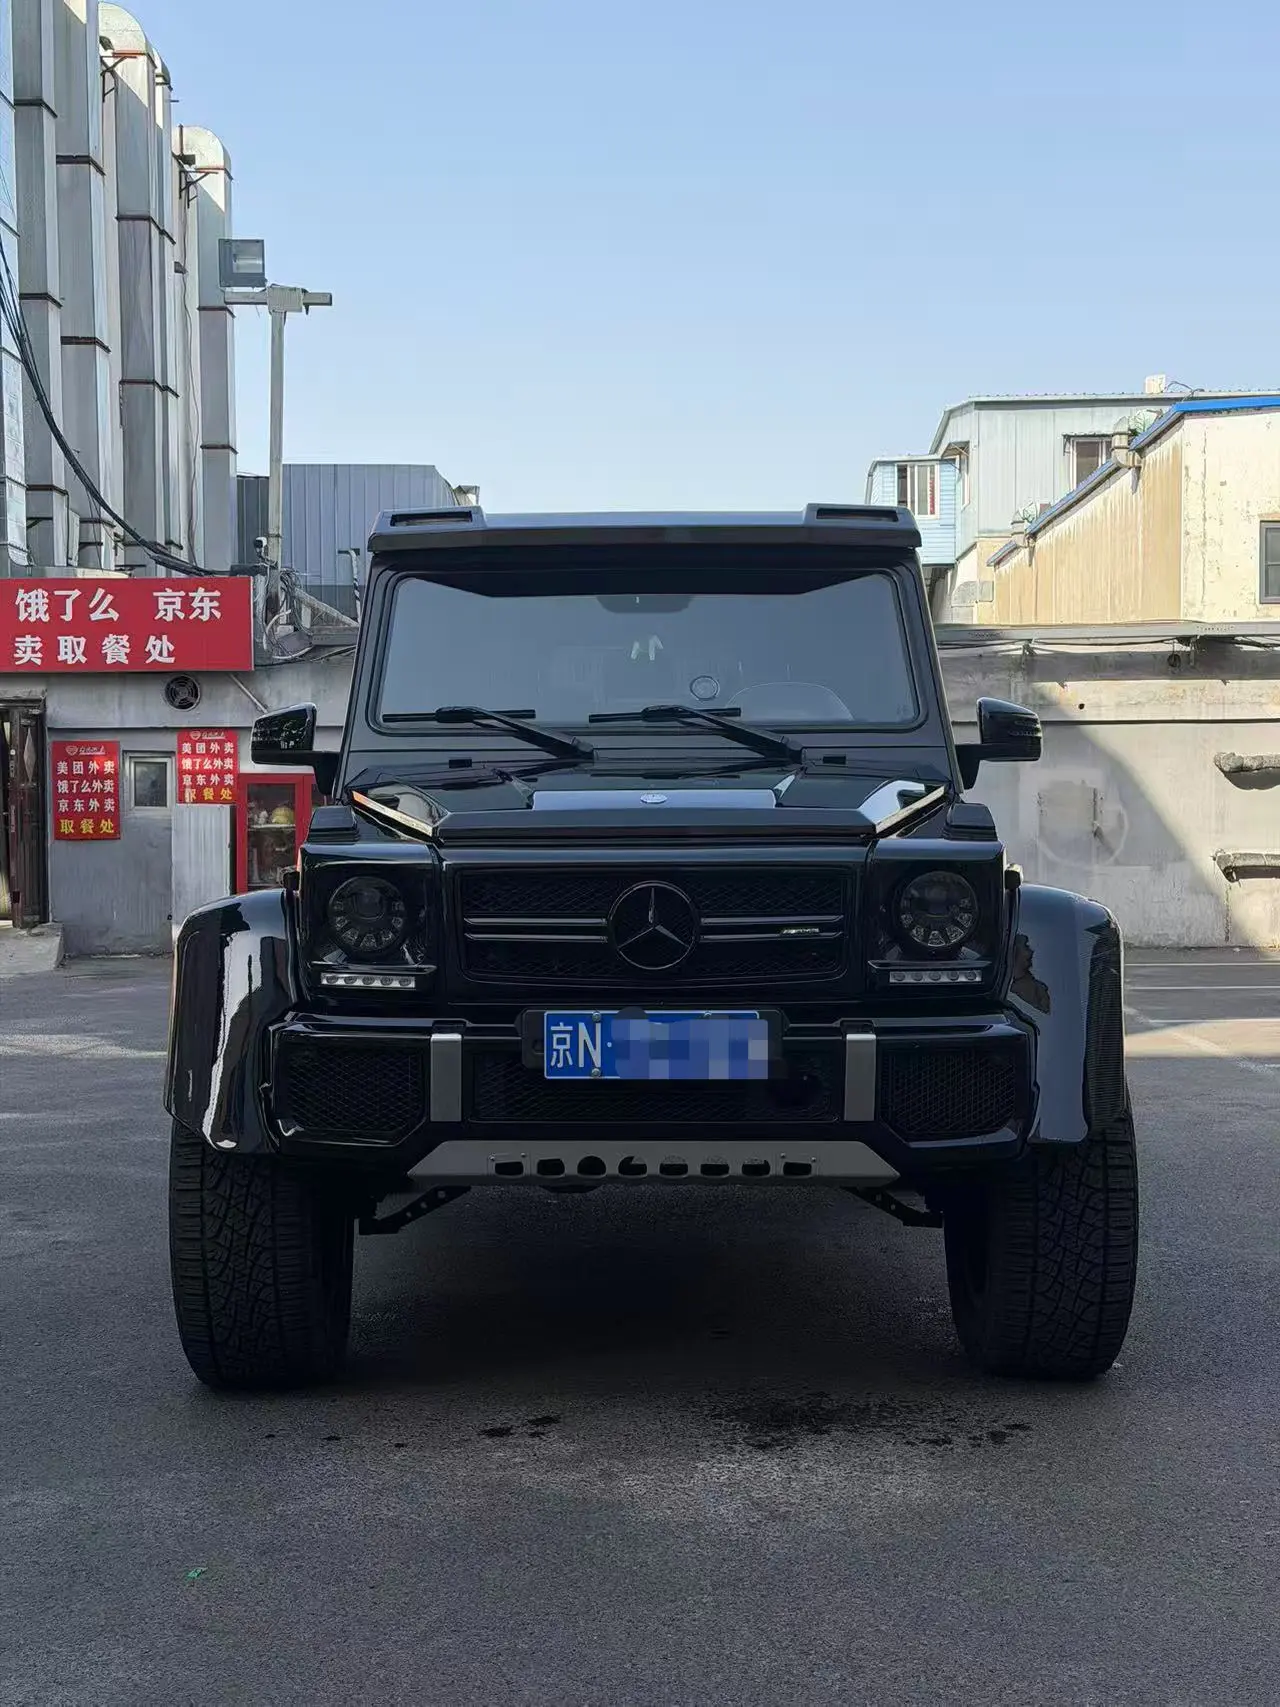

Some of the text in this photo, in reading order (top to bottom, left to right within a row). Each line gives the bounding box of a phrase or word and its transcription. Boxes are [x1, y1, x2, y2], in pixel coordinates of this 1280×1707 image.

[15, 587, 222, 622] 饿了么 京东
[14, 634, 176, 666] 卖取餐处
[181, 742, 234, 754] 美团外卖
[56, 761, 115, 775] 美团外卖
[181, 757, 233, 770] 饿了么外卖
[57, 779, 114, 794] 饿了么外卖
[182, 773, 234, 786] 京东外卖
[57, 798, 115, 813] 京东外卖
[60, 818, 115, 834] 取餐处
